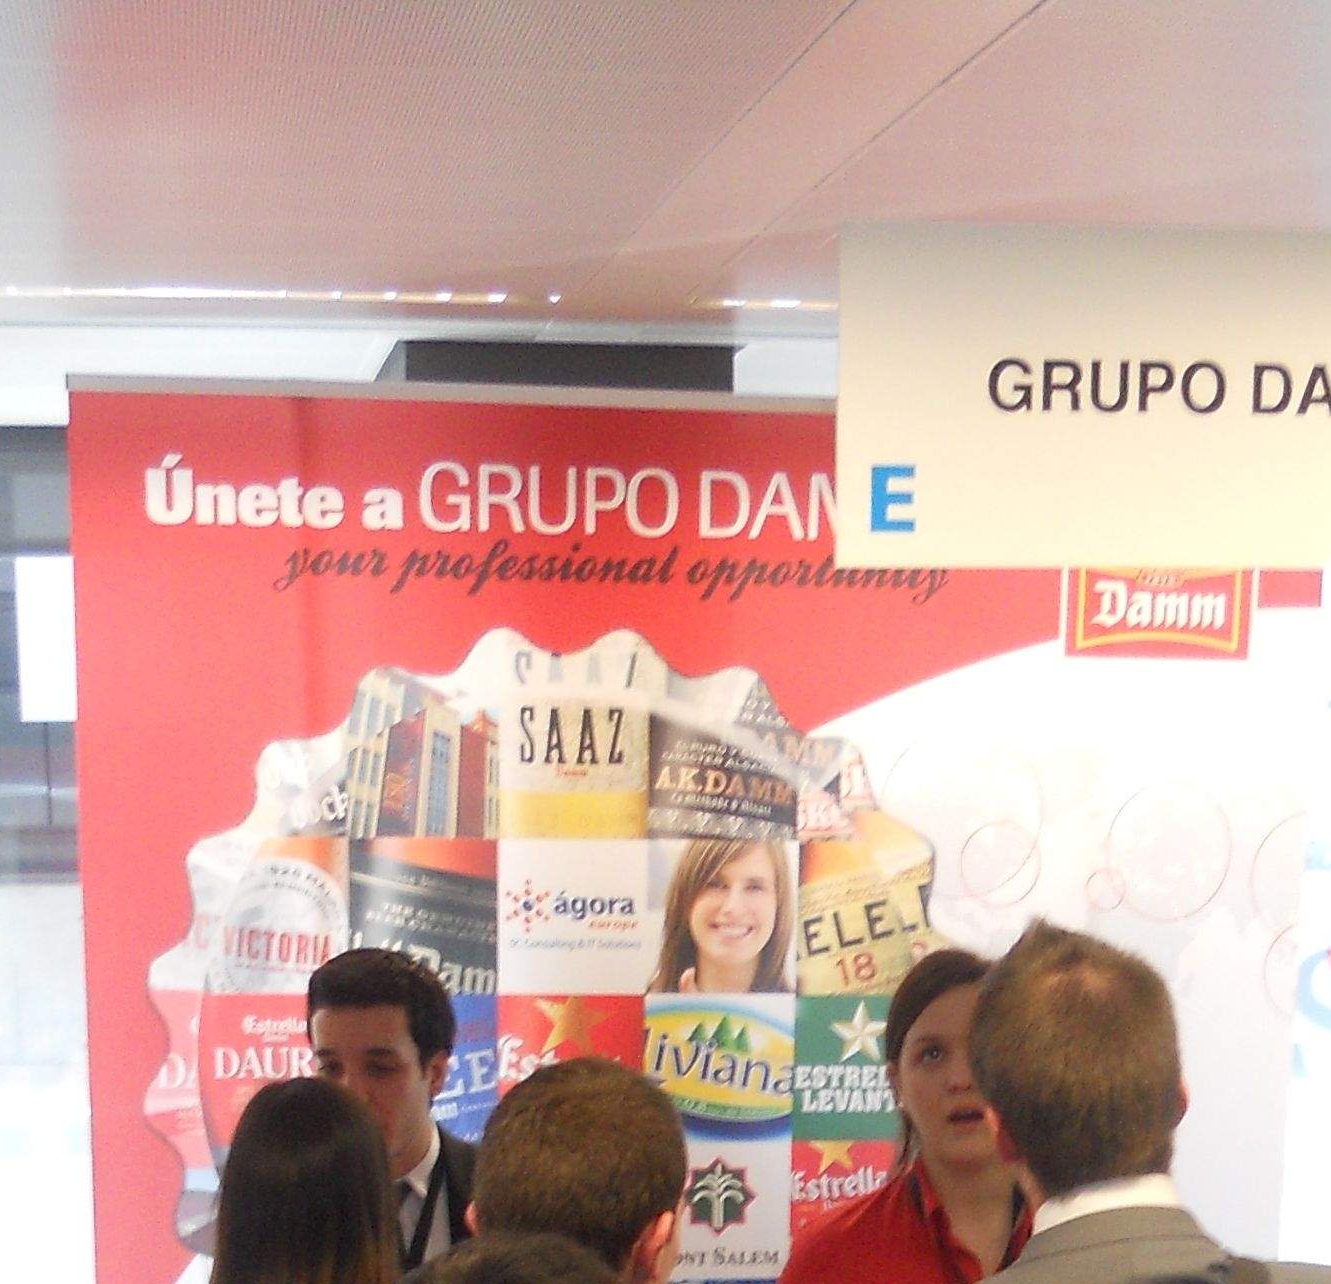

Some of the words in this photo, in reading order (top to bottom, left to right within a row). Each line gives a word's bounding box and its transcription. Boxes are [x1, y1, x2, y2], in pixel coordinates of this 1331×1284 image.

[987, 357, 1226, 415] GRUPO
[145, 453, 345, 530] Únete
[361, 487, 405, 531] a
[419, 460, 679, 538] GRUPO
[697, 470, 837, 541] DA
[869, 464, 917, 533] E
[273, 547, 387, 593] your
[389, 540, 679, 595] professional
[1090, 578, 1227, 631] Damm
[520, 705, 624, 764] SAAZ
[554, 890, 636, 920] ágora
[213, 1047, 315, 1080] DAUR
[795, 1064, 891, 1089] ESTREL
[801, 1089, 896, 1113] LEVANT
